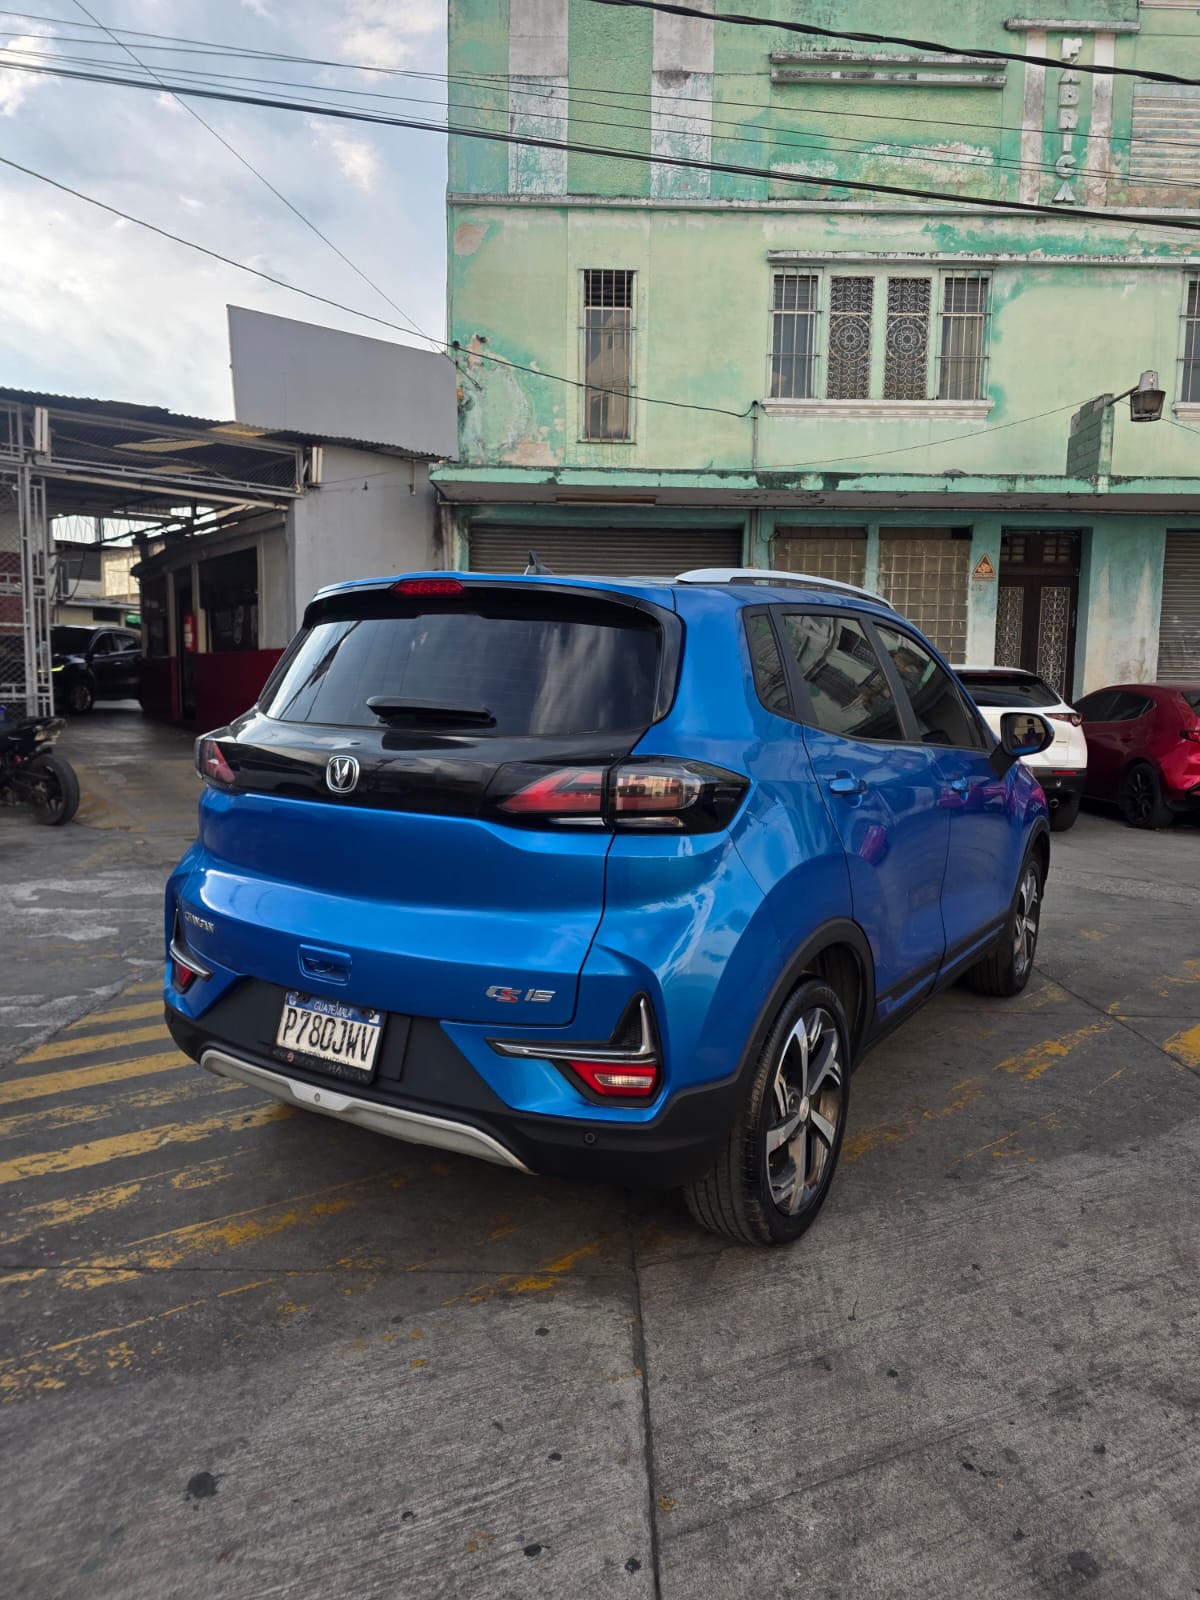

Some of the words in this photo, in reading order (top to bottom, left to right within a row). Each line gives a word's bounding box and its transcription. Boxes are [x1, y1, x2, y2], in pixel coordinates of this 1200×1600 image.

[486, 986, 522, 1003] CS
[313, 1001, 353, 1019] GUATEMALA
[283, 1007, 375, 1062] P780JWV
